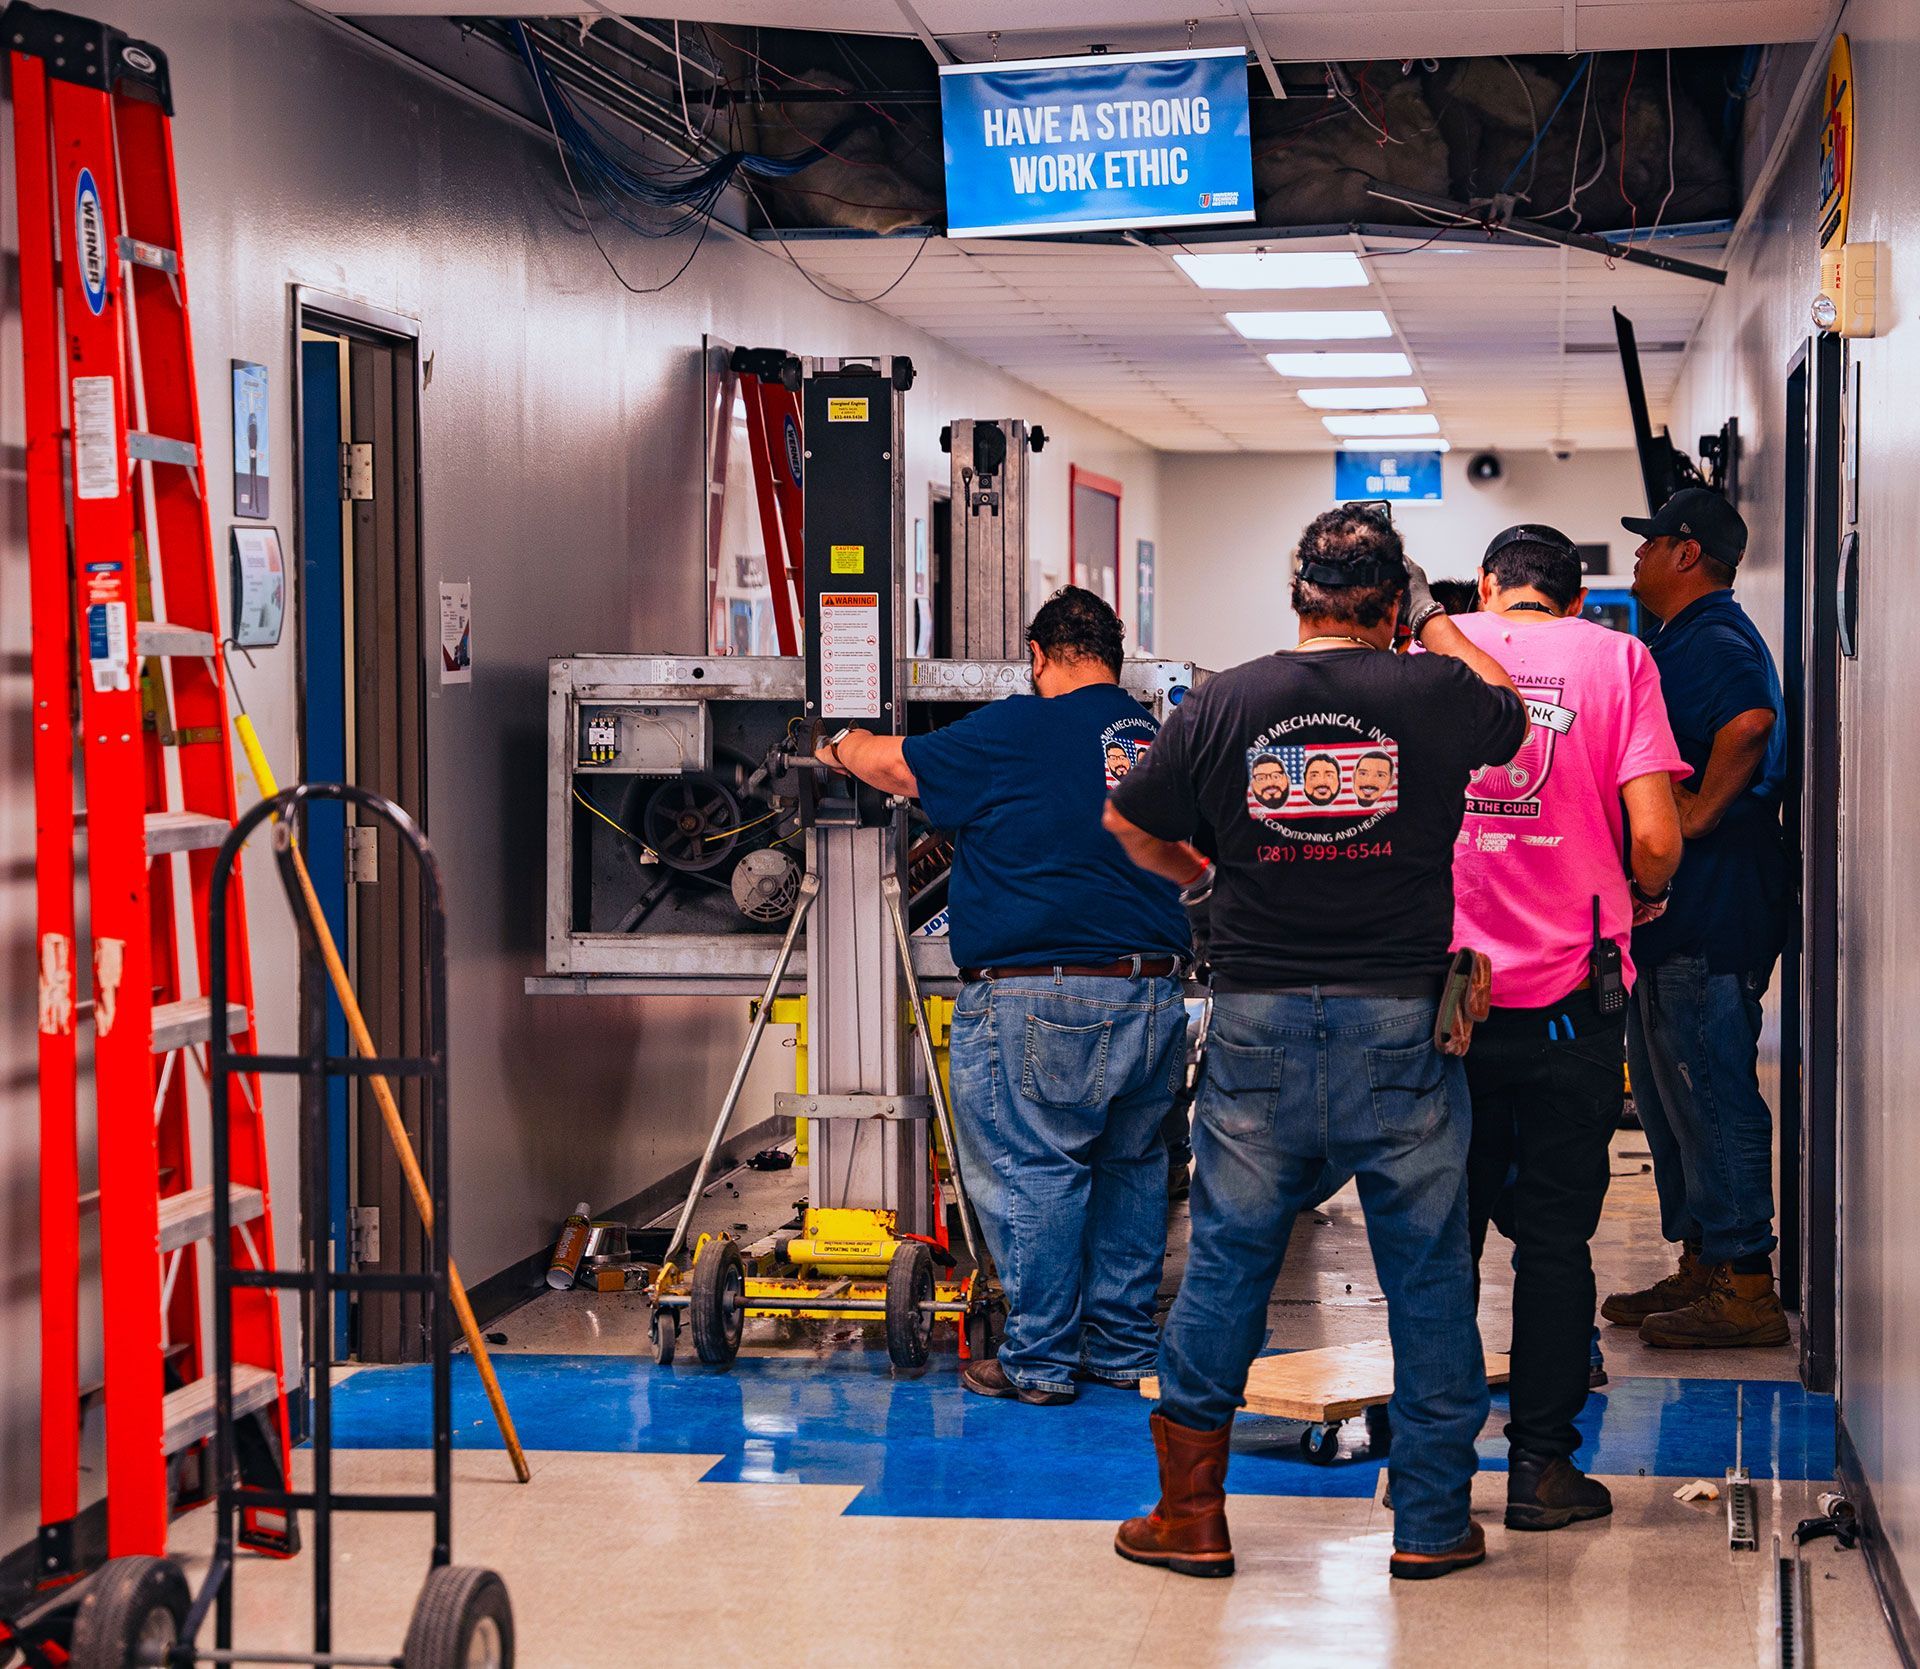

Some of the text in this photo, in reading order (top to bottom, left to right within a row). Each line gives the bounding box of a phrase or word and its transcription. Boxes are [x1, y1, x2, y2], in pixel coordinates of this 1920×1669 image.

[983, 96, 1210, 147] HAVE A STRONG
[1010, 147, 1188, 194] WORK ETHIC
[83, 201, 99, 284] WERNER
[788, 429, 801, 473] WERNER
[835, 596, 875, 605] WARNING!
[1510, 675, 1566, 686] CHANICS
[1527, 705, 1555, 722] NK
[1112, 718, 1158, 736] MECHANICAL
[1268, 712, 1364, 739] MECHANICAL,
[1478, 802, 1500, 813] THE
[1503, 803, 1537, 814] CURE
[1264, 818, 1334, 842] CONDITIONING
[1335, 826, 1358, 842] AND
[1358, 803, 1394, 834] HEATIN
[1482, 832, 1517, 840] AMERICAN
[1529, 836, 1564, 845] MIAT
[1257, 841, 1393, 862] (281) 999-6544
[923, 910, 949, 936] tor
